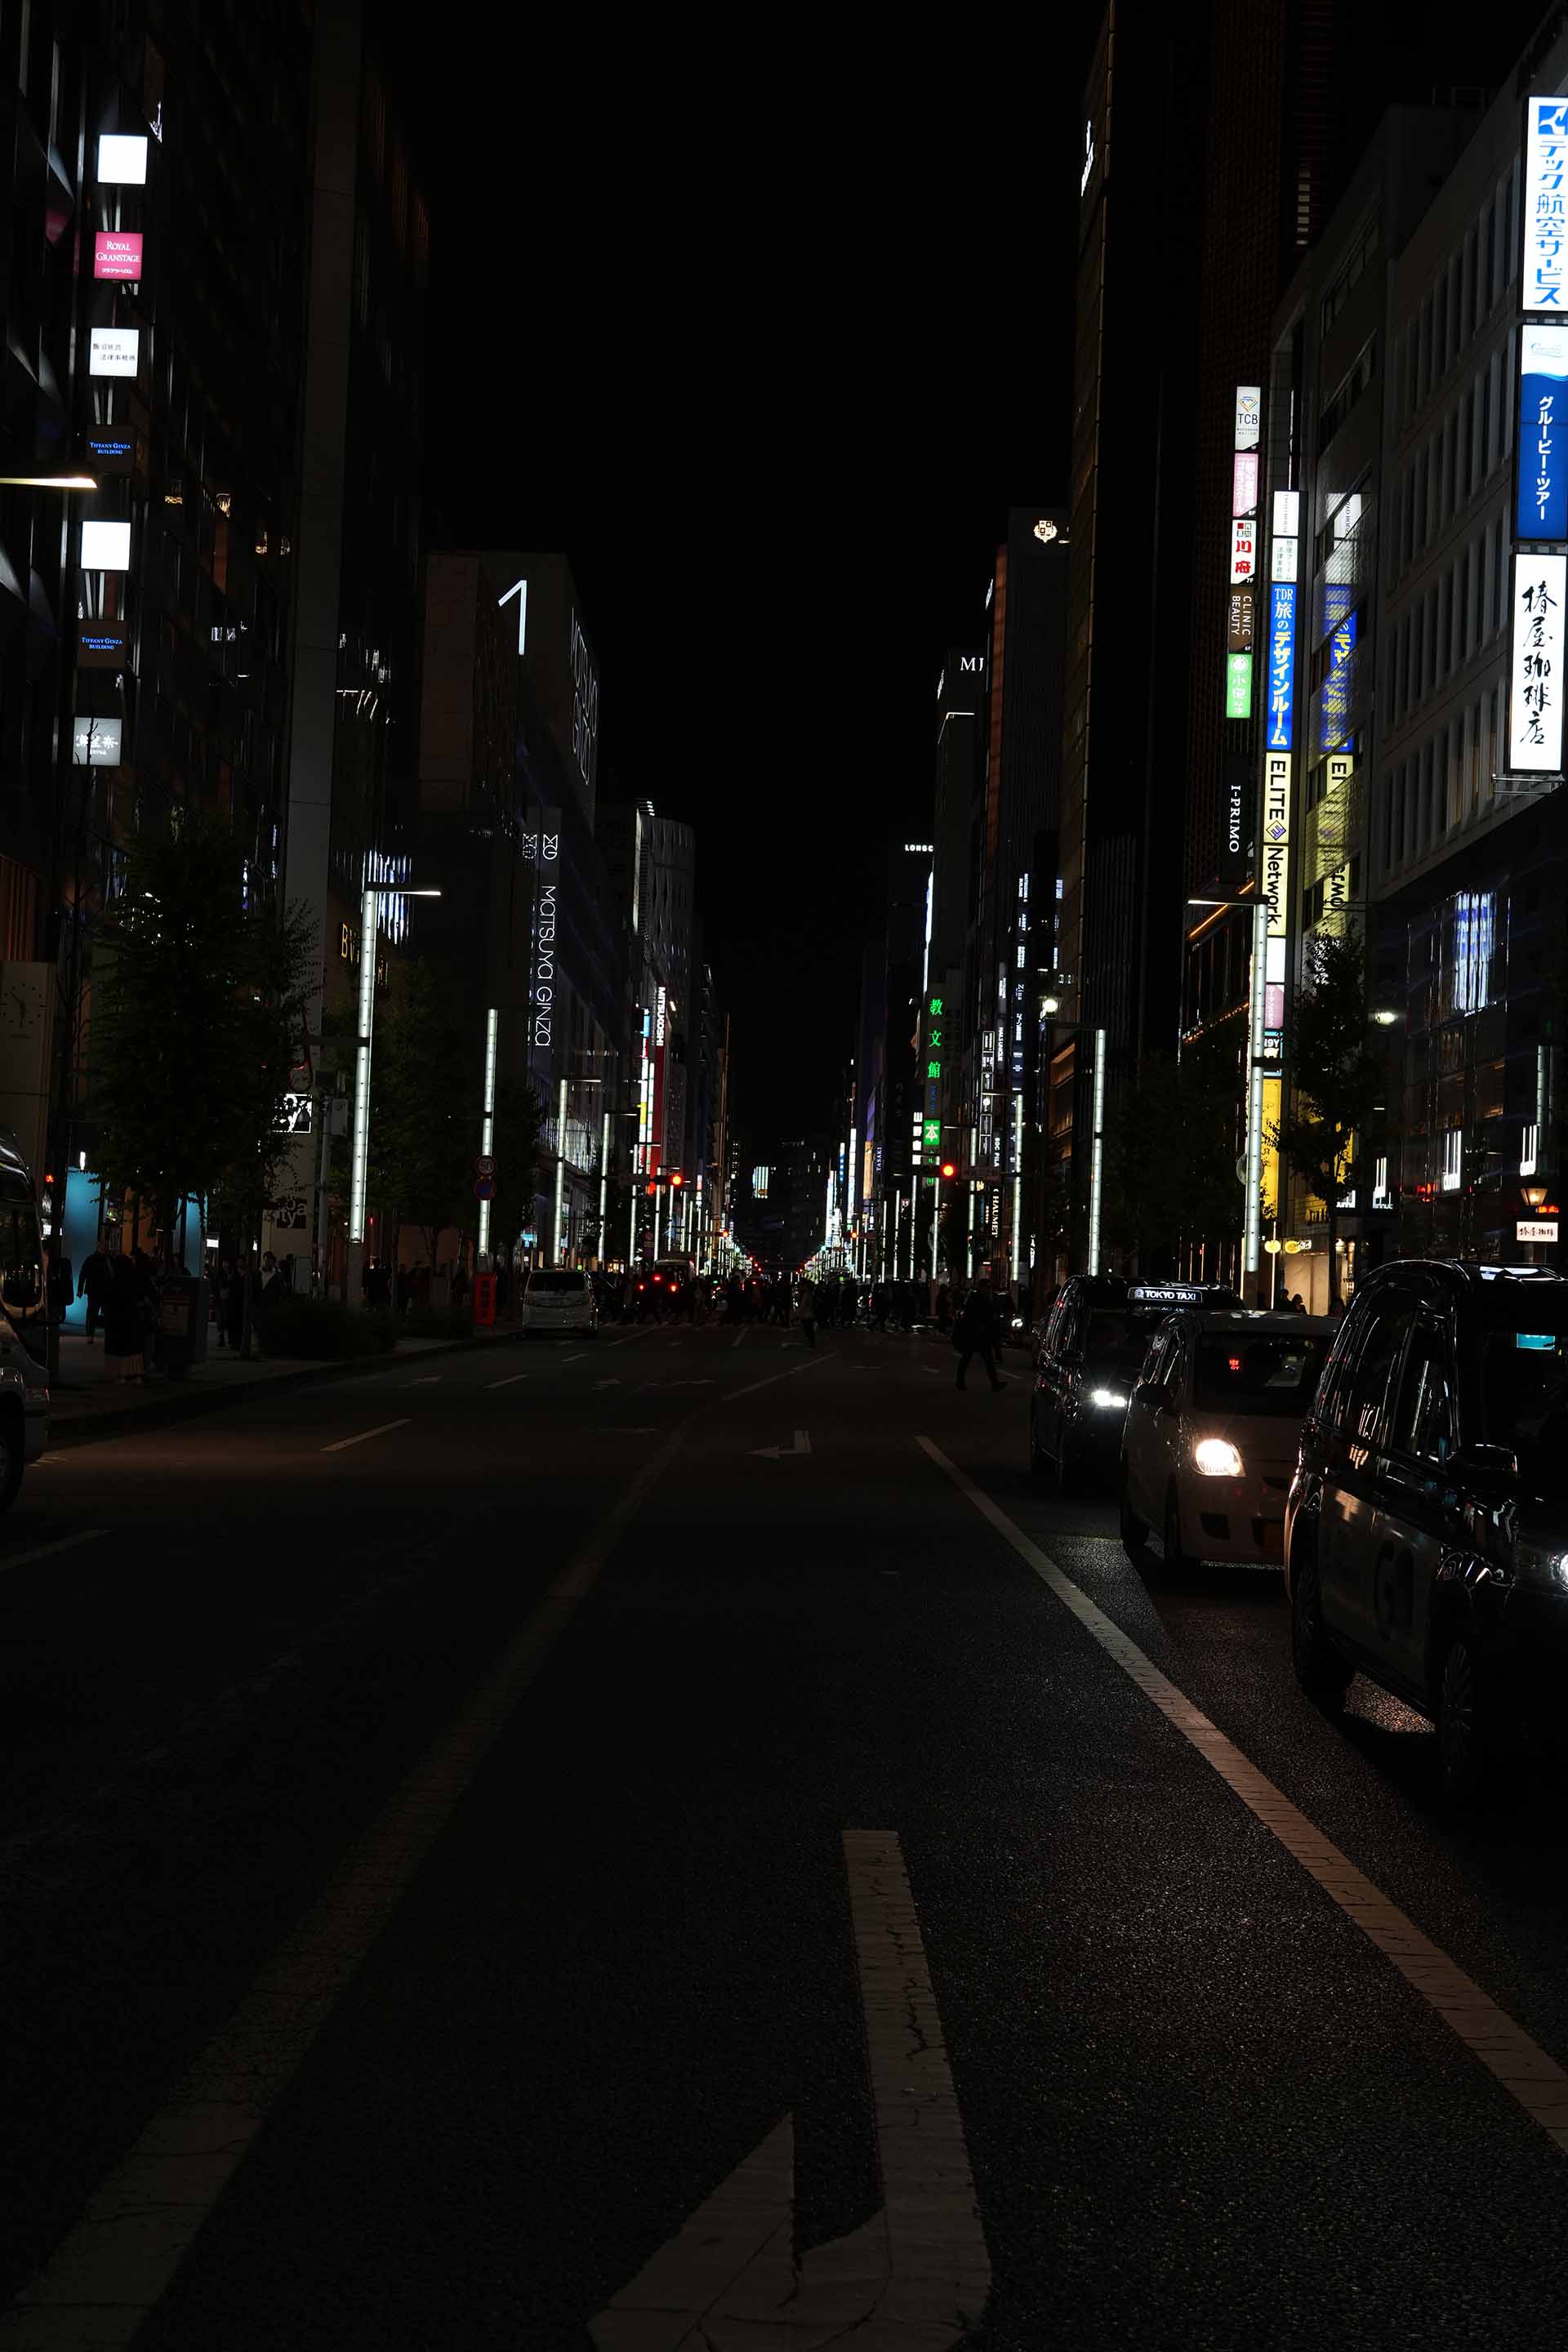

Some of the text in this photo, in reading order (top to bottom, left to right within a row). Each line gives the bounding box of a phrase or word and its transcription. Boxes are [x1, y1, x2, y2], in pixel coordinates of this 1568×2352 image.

[96, 252, 140, 262] GRANSTAGE
[106, 241, 131, 251] ROYAL
[1237, 412, 1258, 425] TCB
[1274, 588, 1294, 601] TDR
[1231, 595, 1241, 635] BEAUTY
[1241, 595, 1252, 635] CLINIC
[1520, 580, 1558, 745] 椿屋珈琲店
[1269, 760, 1287, 820] ELITE
[1229, 785, 1241, 853] I-PRIMO
[656, 987, 666, 1046] MITSUKOSHI
[928, 999, 943, 1078] 教文館
[991, 1188, 1000, 1238] CHAUMET
[1144, 1290, 1196, 1301] TOKYO TAXI
